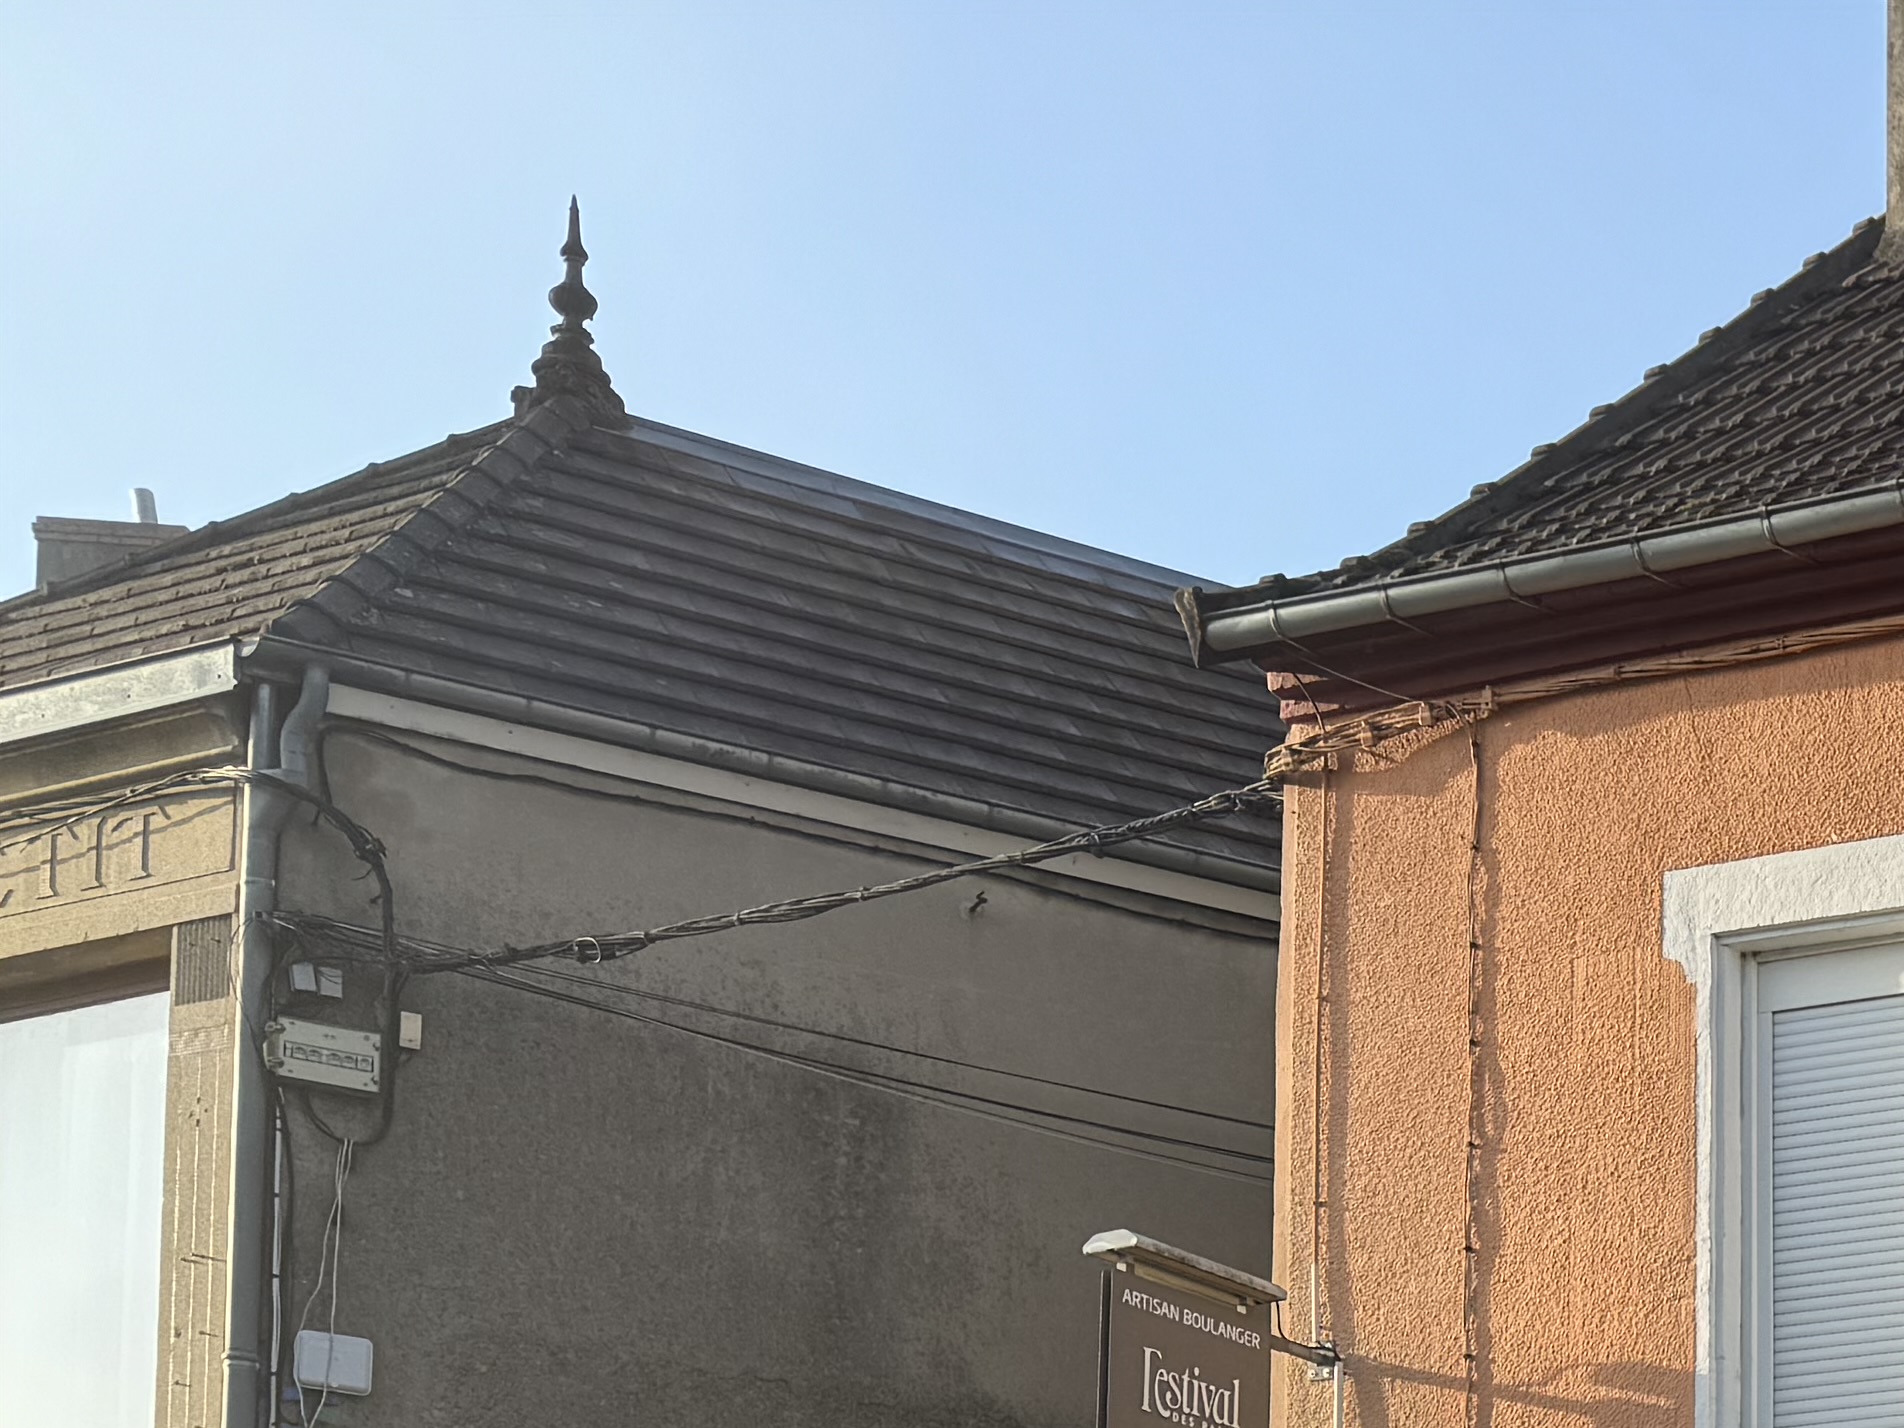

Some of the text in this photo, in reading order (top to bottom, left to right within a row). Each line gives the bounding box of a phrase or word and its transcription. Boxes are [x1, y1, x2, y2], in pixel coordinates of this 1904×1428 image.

[0, 804, 172, 909] TIT
[1122, 1288, 1261, 1350] ARTISAN BOULANGER
[1172, 1412, 1195, 1428] DES
